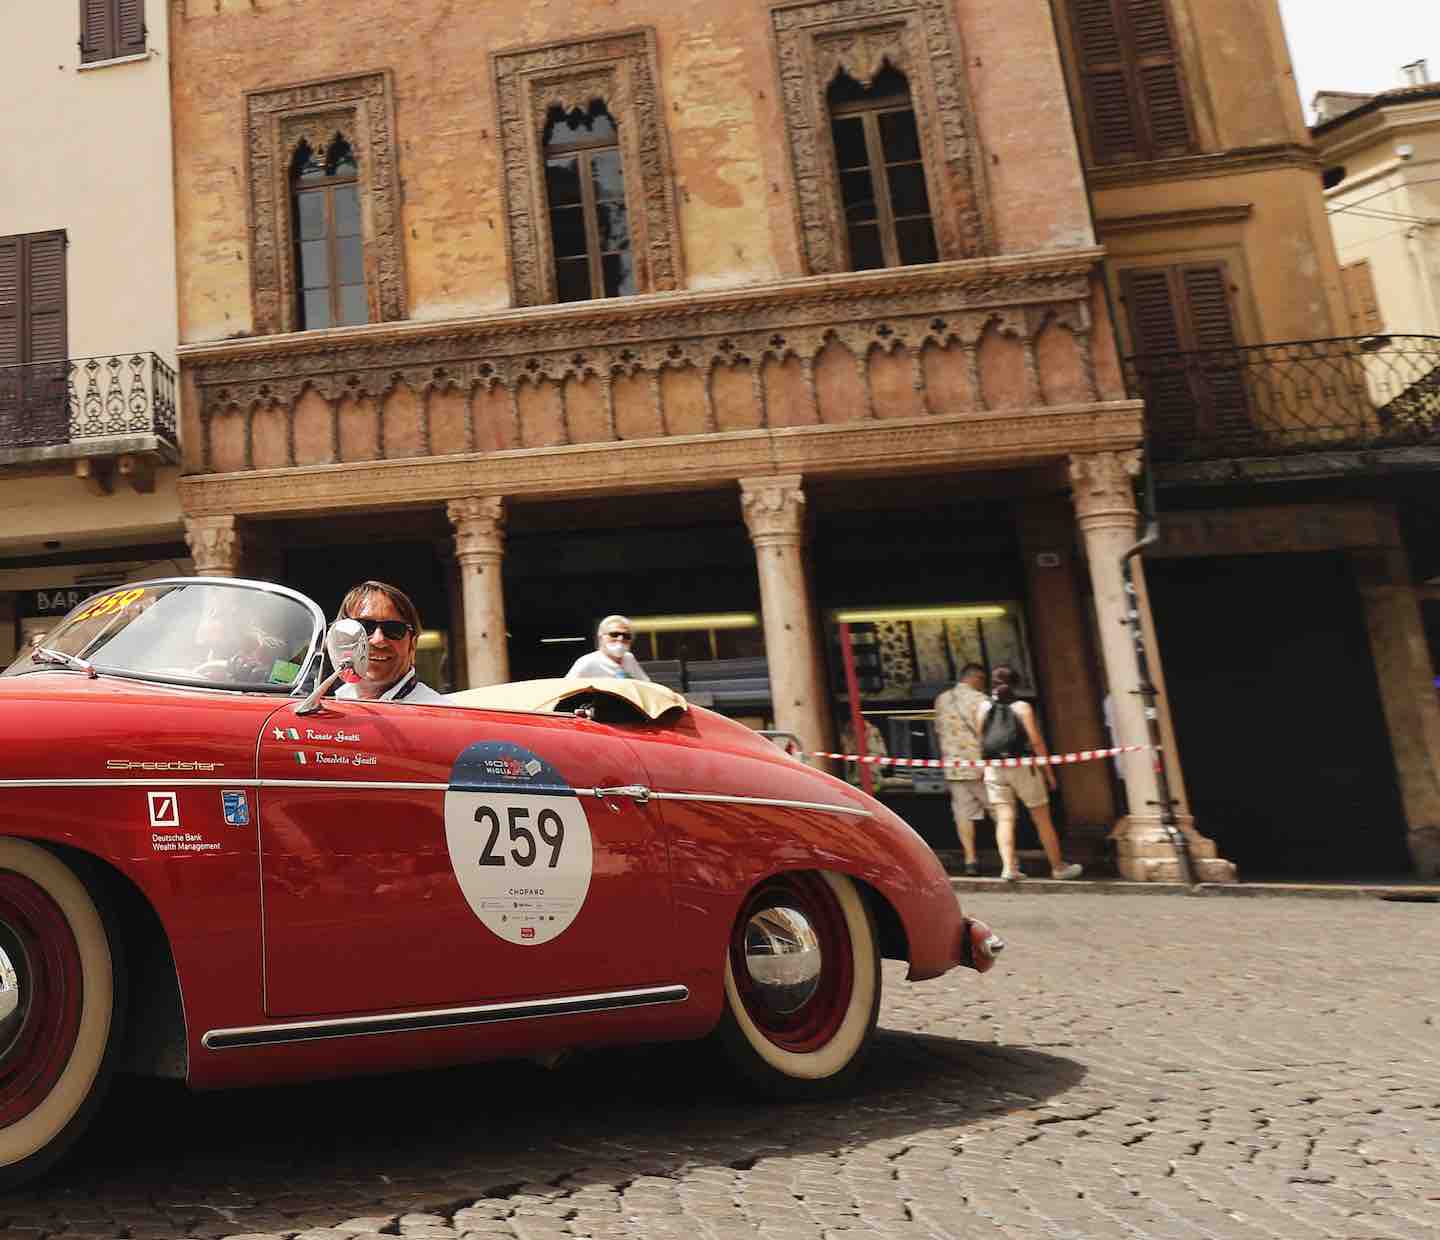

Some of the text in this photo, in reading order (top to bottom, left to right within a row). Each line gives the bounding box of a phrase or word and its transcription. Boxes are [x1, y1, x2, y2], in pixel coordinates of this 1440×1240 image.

[37, 592, 80, 610] BAR
[106, 759, 224, 771] Speedster
[152, 833, 202, 842] Deutsche Bank
[474, 805, 565, 869] 259
[152, 842, 221, 852] Wealth Management
[508, 888, 545, 897] CHOPARD
